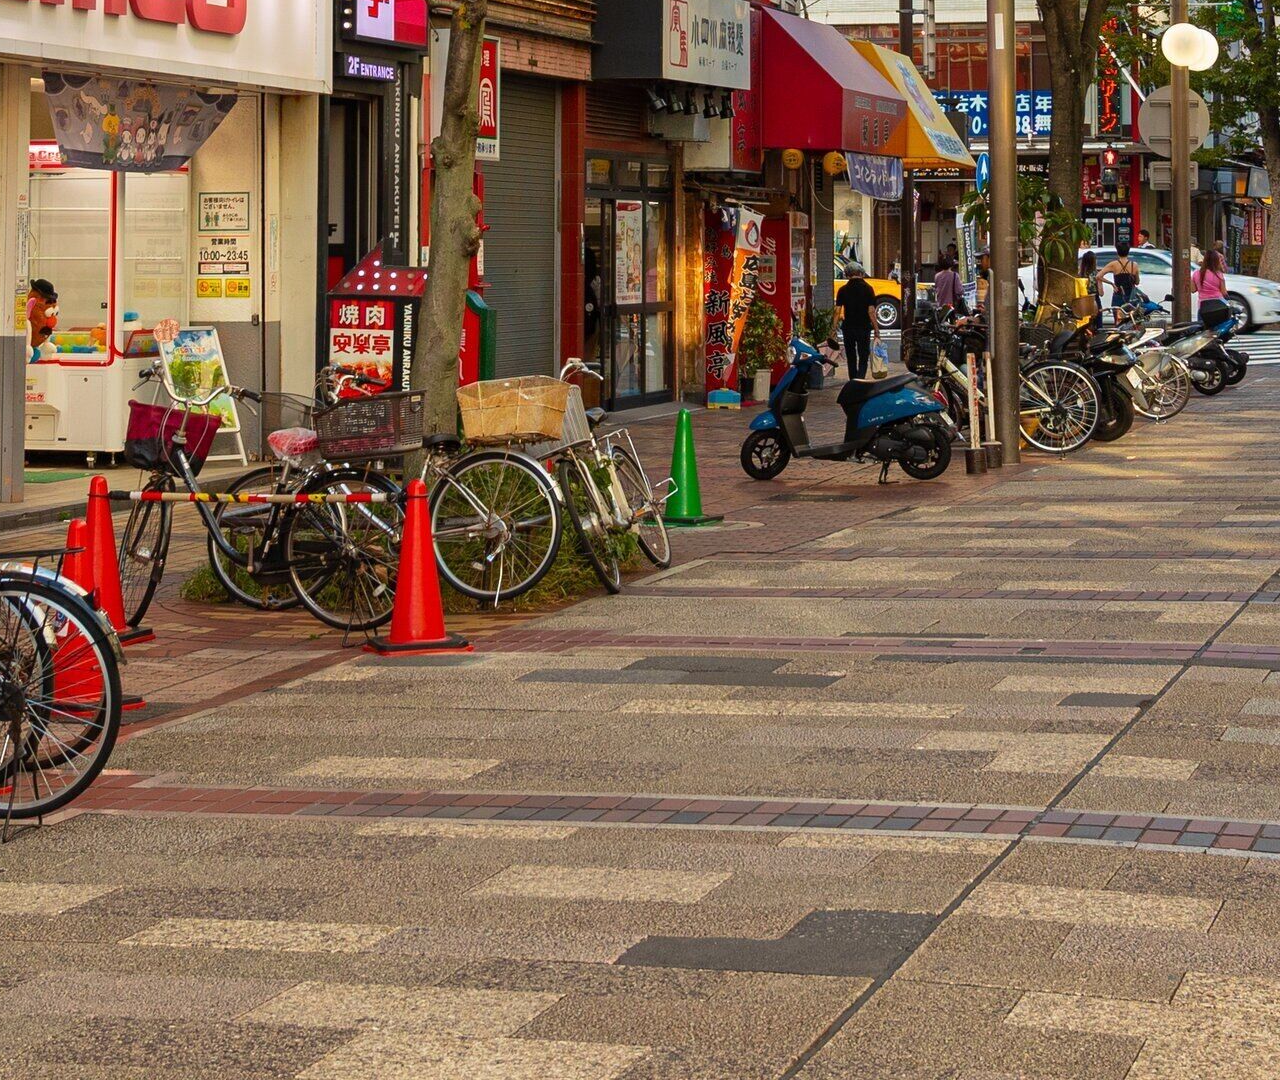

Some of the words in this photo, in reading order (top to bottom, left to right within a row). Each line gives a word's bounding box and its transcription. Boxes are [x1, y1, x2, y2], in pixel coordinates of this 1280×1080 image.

[347, 55, 360, 76] 2F
[360, 63, 395, 80] ENTRANCE
[210, 238, 237, 246] 営業時間
[338, 304, 385, 326] 焼肉
[403, 303, 413, 348] YAKINIKU
[332, 332, 391, 355] 安楽亭
[402, 349, 412, 393] ANRAKUT
